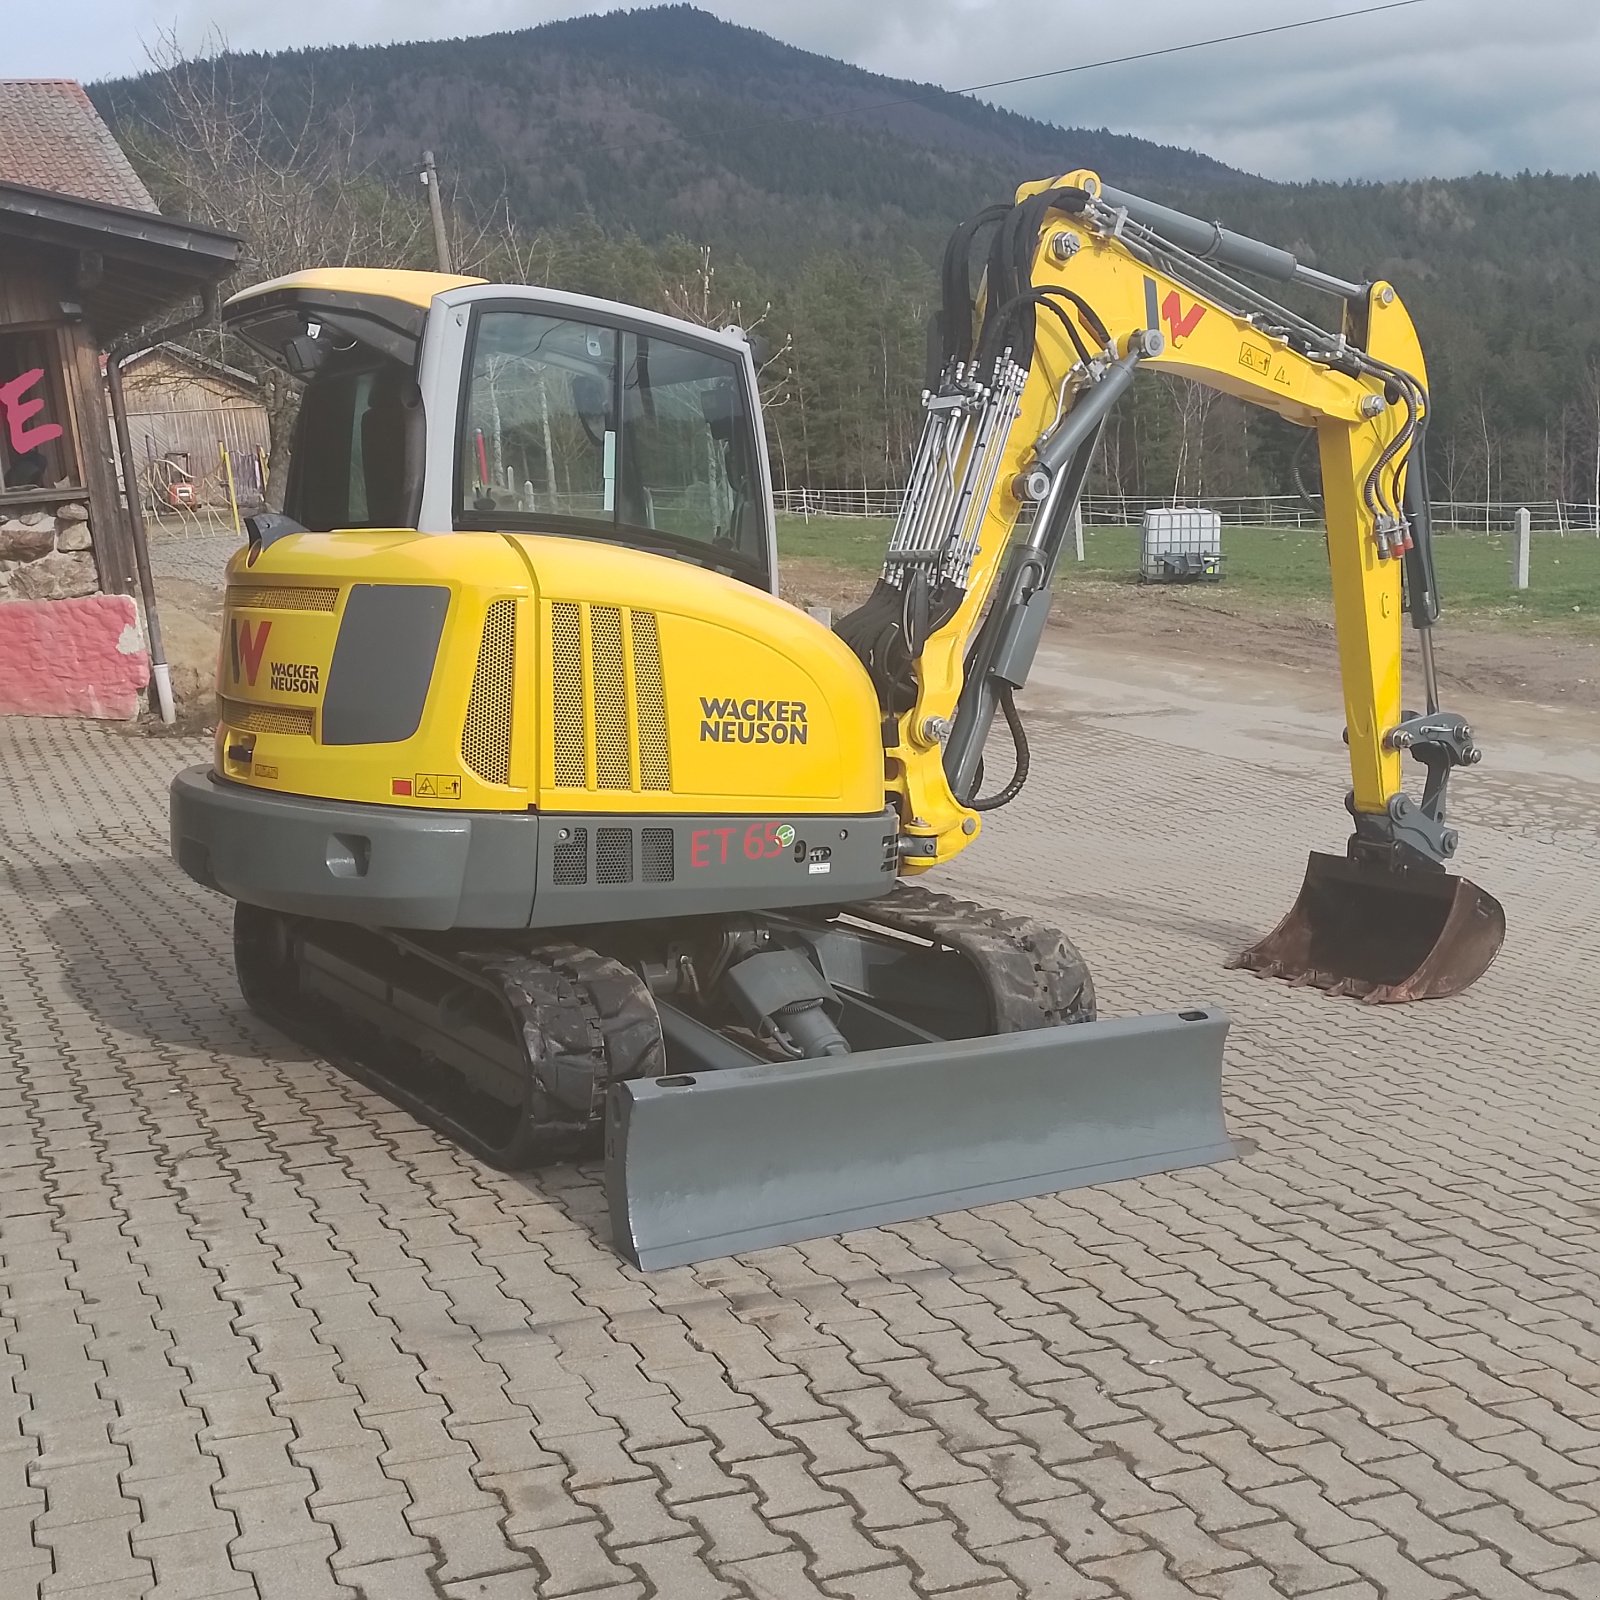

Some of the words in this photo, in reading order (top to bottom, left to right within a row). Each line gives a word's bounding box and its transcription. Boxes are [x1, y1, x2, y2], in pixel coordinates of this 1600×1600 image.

[230, 618, 273, 687] W
[270, 661, 319, 680] WACKER
[270, 676, 319, 694] NEUSON
[699, 697, 808, 723] WACKER
[699, 720, 808, 745] NEUSON
[690, 827, 737, 868] ET
[742, 821, 785, 861] 65
